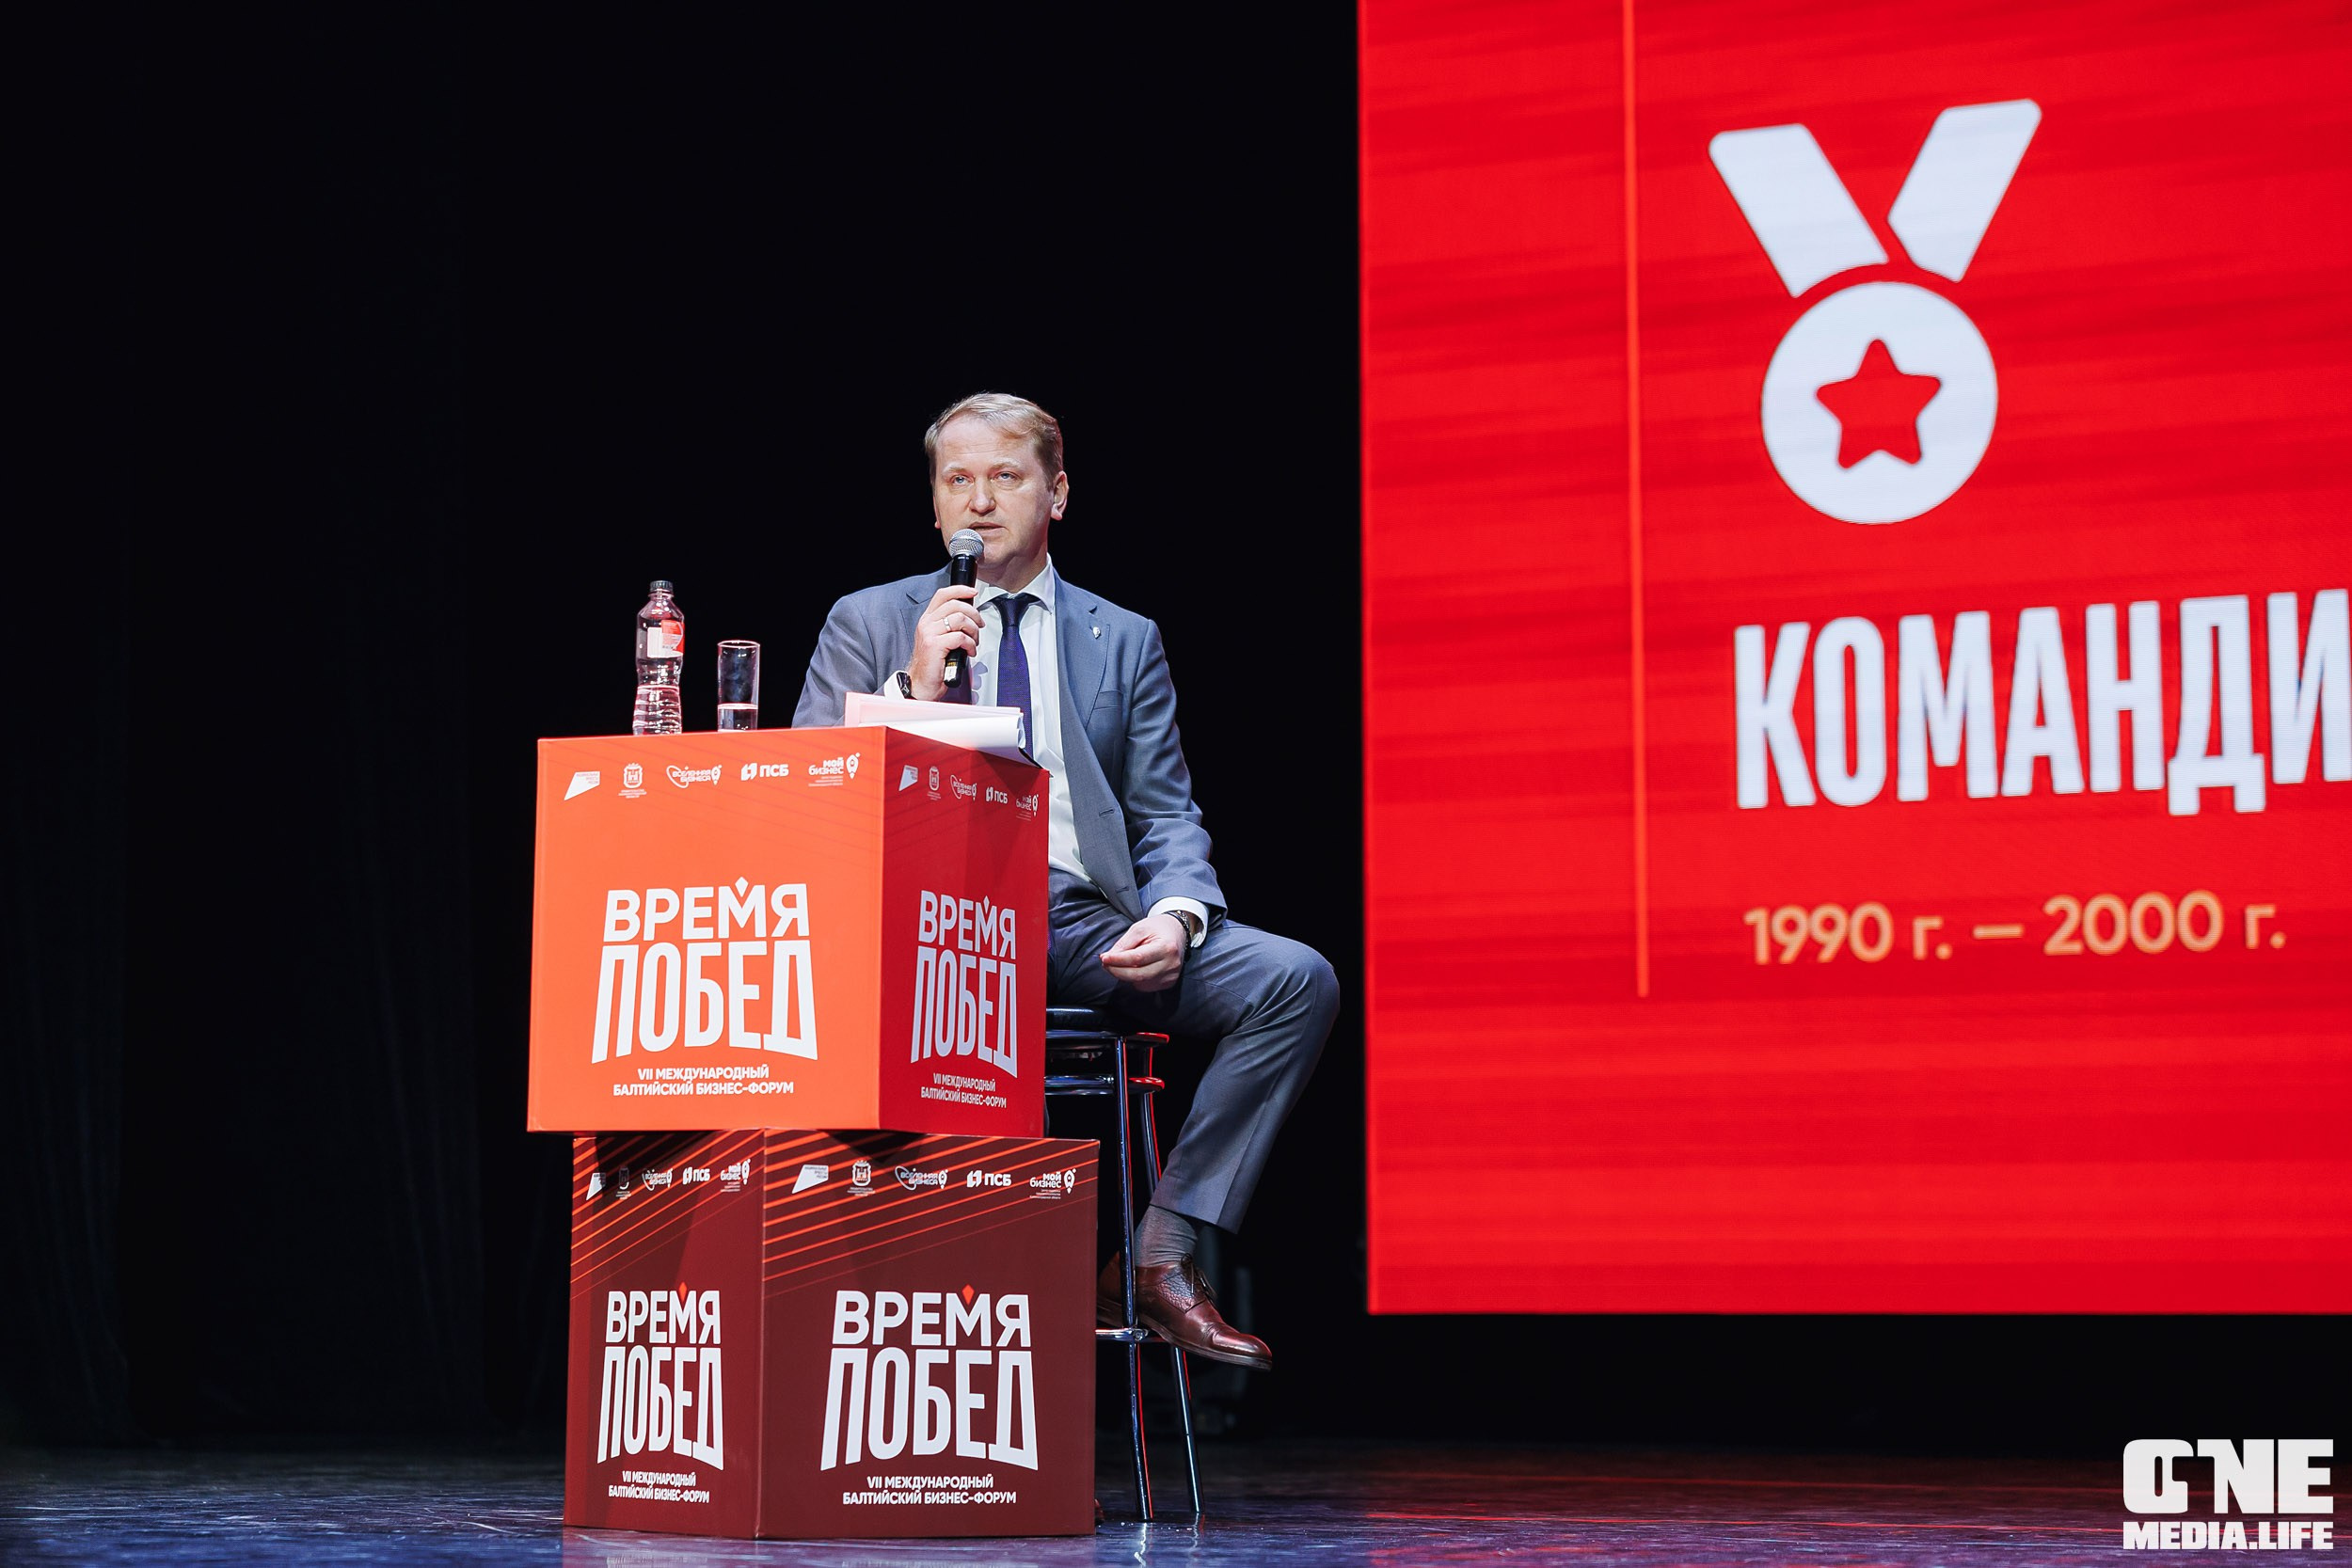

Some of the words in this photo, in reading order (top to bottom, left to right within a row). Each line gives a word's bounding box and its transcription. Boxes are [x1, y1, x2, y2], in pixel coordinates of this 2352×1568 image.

[1734, 588, 2352, 816] КОМАНДИ
[759, 764, 789, 777] ПСБ
[993, 790, 1009, 804] ПСБ
[603, 877, 810, 942] ВРЕМЯ
[919, 889, 1016, 959] ВРЕМЯ
[1744, 902, 1894, 965] 1990
[1913, 916, 1952, 959] г.
[2043, 890, 2223, 956] 2000
[2245, 904, 2286, 949] г.
[591, 940, 818, 1064] ПОБЕД
[911, 946, 1018, 1078] ПОБЕД
[638, 1068, 653, 1080] VII
[655, 1064, 770, 1081] МЕЖДУНАРОДНЫЙ
[613, 1081, 693, 1096] БАЛТИЙСКИЙ
[695, 1082, 794, 1095] БИЗНЕС-ФОРУМ
[942, 1073, 995, 1091] МЕЖДУНАРОДНЫЙ
[921, 1086, 960, 1102] БАЛТИЙСКИЙ
[961, 1091, 1007, 1108] БИЗНЕС-ФОРУМ
[693, 1168, 710, 1181] ПСБ
[984, 1173, 1012, 1186] ПСБ
[1029, 1177, 1061, 1188] бизнес
[1042, 1171, 1061, 1181] мой
[605, 1289, 721, 1344] ВРЕМЯ
[832, 1289, 1031, 1348] ВРЕМЯ
[597, 1346, 723, 1471] ПОБЕД
[820, 1347, 1038, 1471] ПОБЕД
[632, 1471, 696, 1487] МЕЖДУНАРОДНЫЙ
[867, 1477, 882, 1488] VII
[884, 1474, 993, 1490] МЕЖДУНАРОДНЫЙ
[609, 1484, 653, 1499] БАЛТИЙСКИЙ
[654, 1489, 710, 1503] БИЗНЕС-ФОРУМ
[843, 1490, 922, 1505] БАЛТИЙСКИЙ
[924, 1492, 1016, 1504] БИЗНЕС-ФОРУМ
